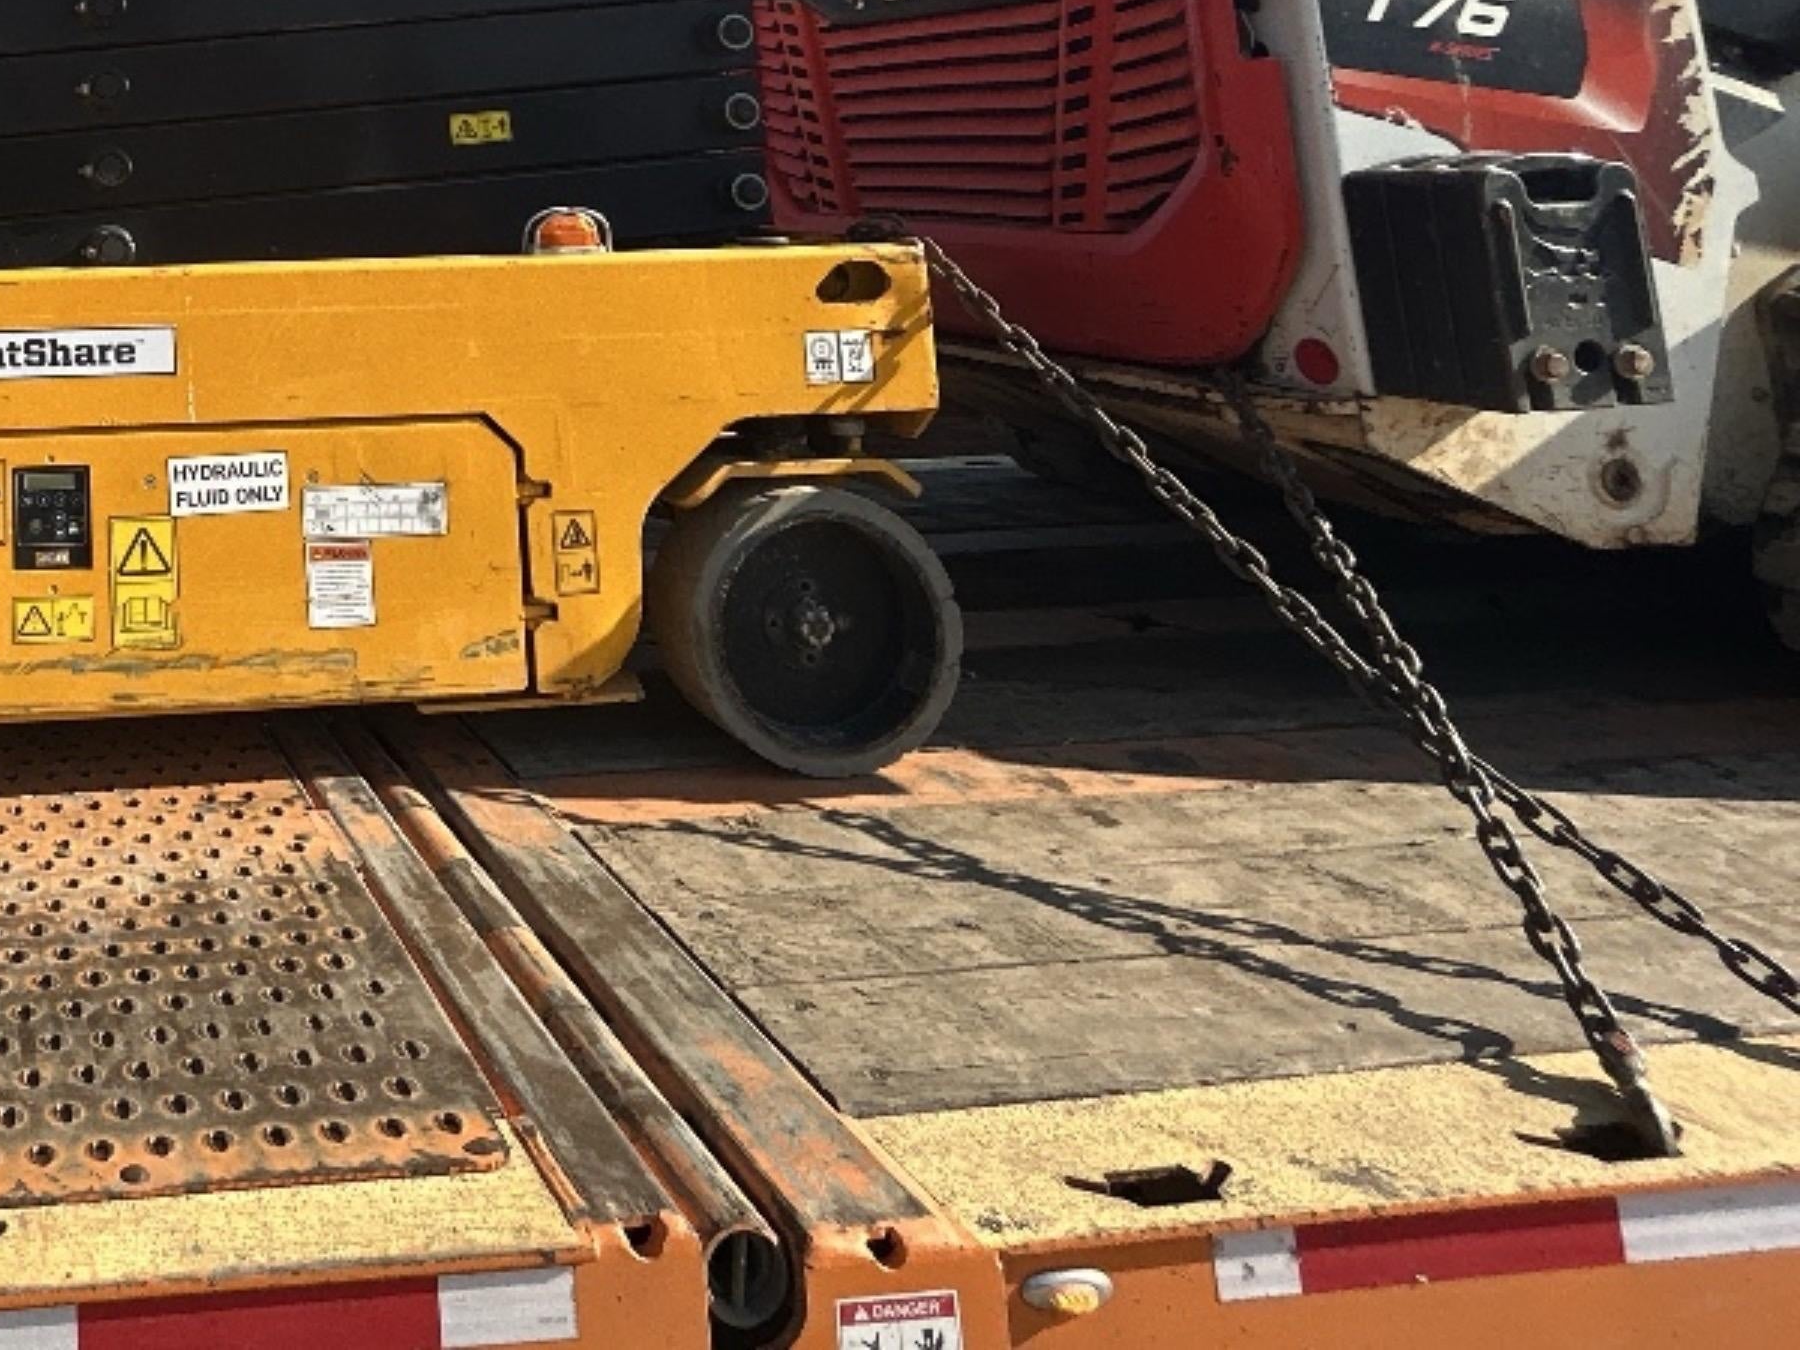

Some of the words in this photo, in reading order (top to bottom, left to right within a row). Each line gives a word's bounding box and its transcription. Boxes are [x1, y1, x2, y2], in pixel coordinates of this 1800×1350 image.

[173, 458, 283, 483] HYDRAULIC
[176, 490, 229, 508] FLUID
[236, 485, 284, 504] ONLY
[872, 1299, 940, 1319] DANGER
